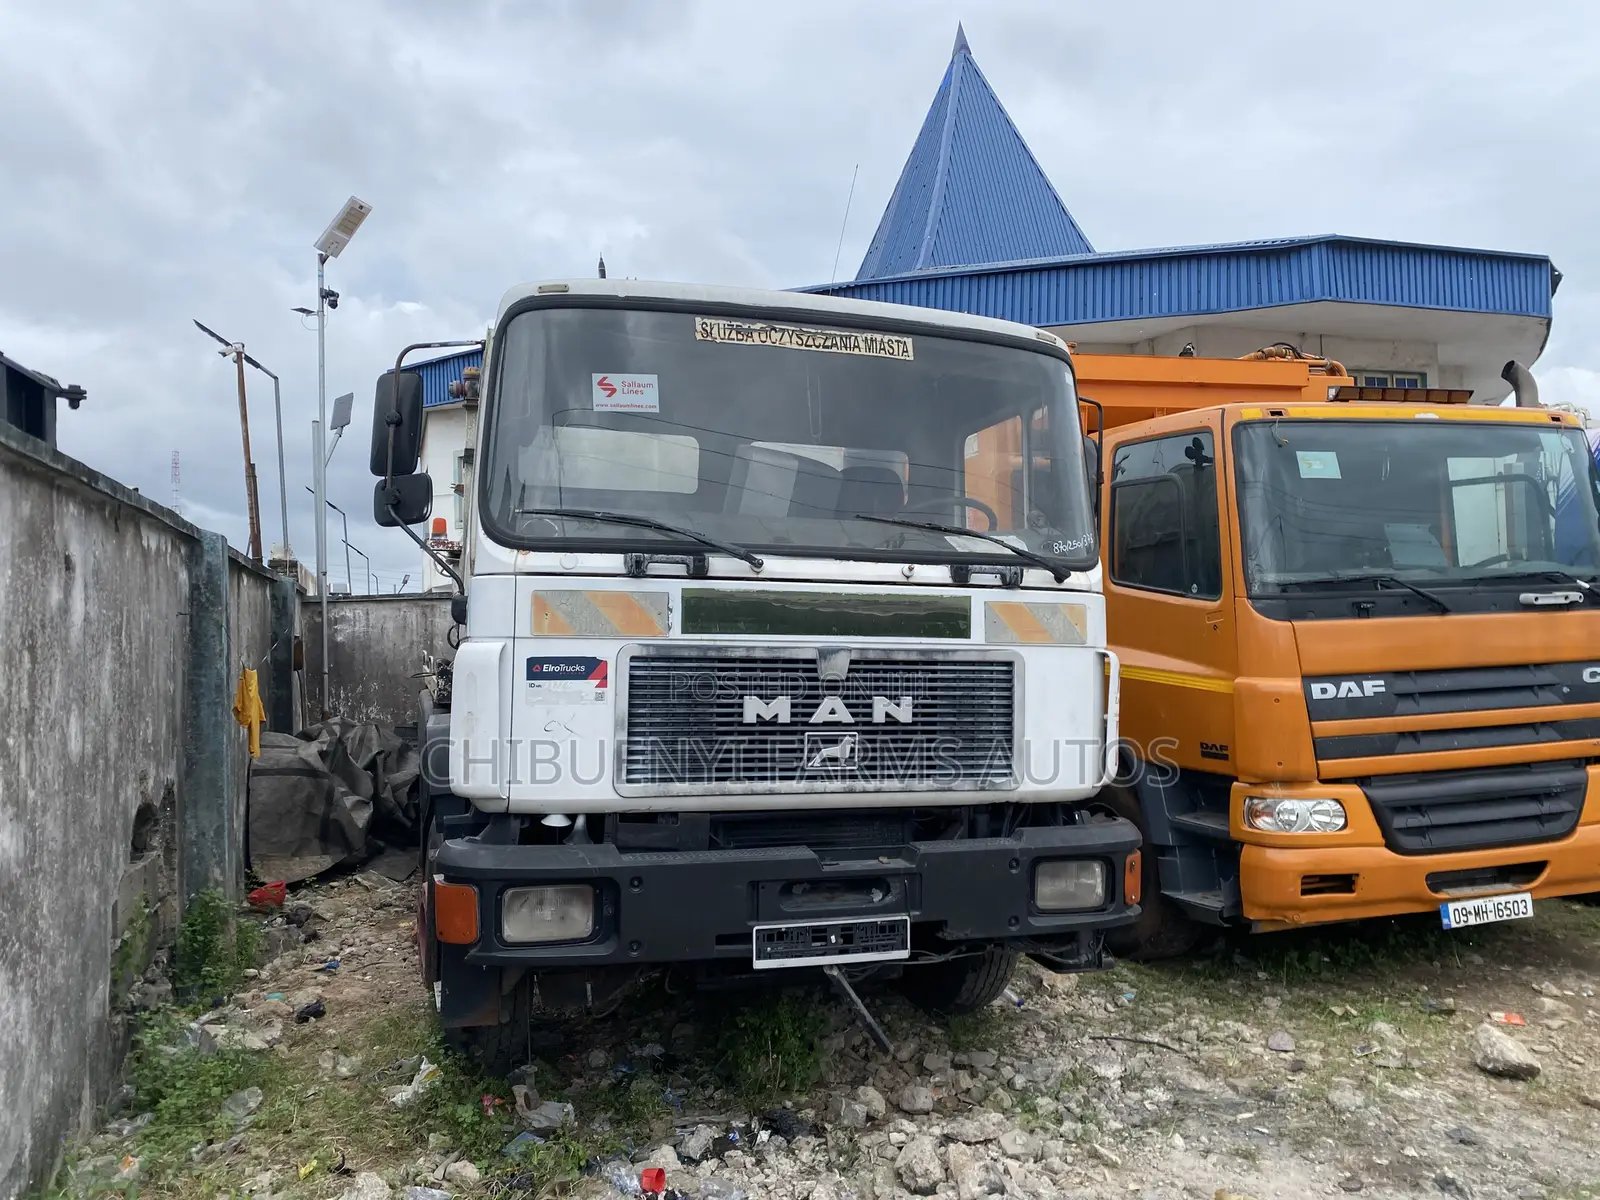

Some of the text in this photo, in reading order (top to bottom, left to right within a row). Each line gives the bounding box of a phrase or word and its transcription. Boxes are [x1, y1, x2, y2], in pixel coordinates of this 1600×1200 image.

[864, 334, 910, 357] MIASTA
[621, 380, 654, 389] Sallaum
[542, 664, 586, 672] ElroTrucks
[1310, 680, 1386, 699] DAF
[743, 696, 912, 724] MAN
[1200, 741, 1228, 752] DAF
